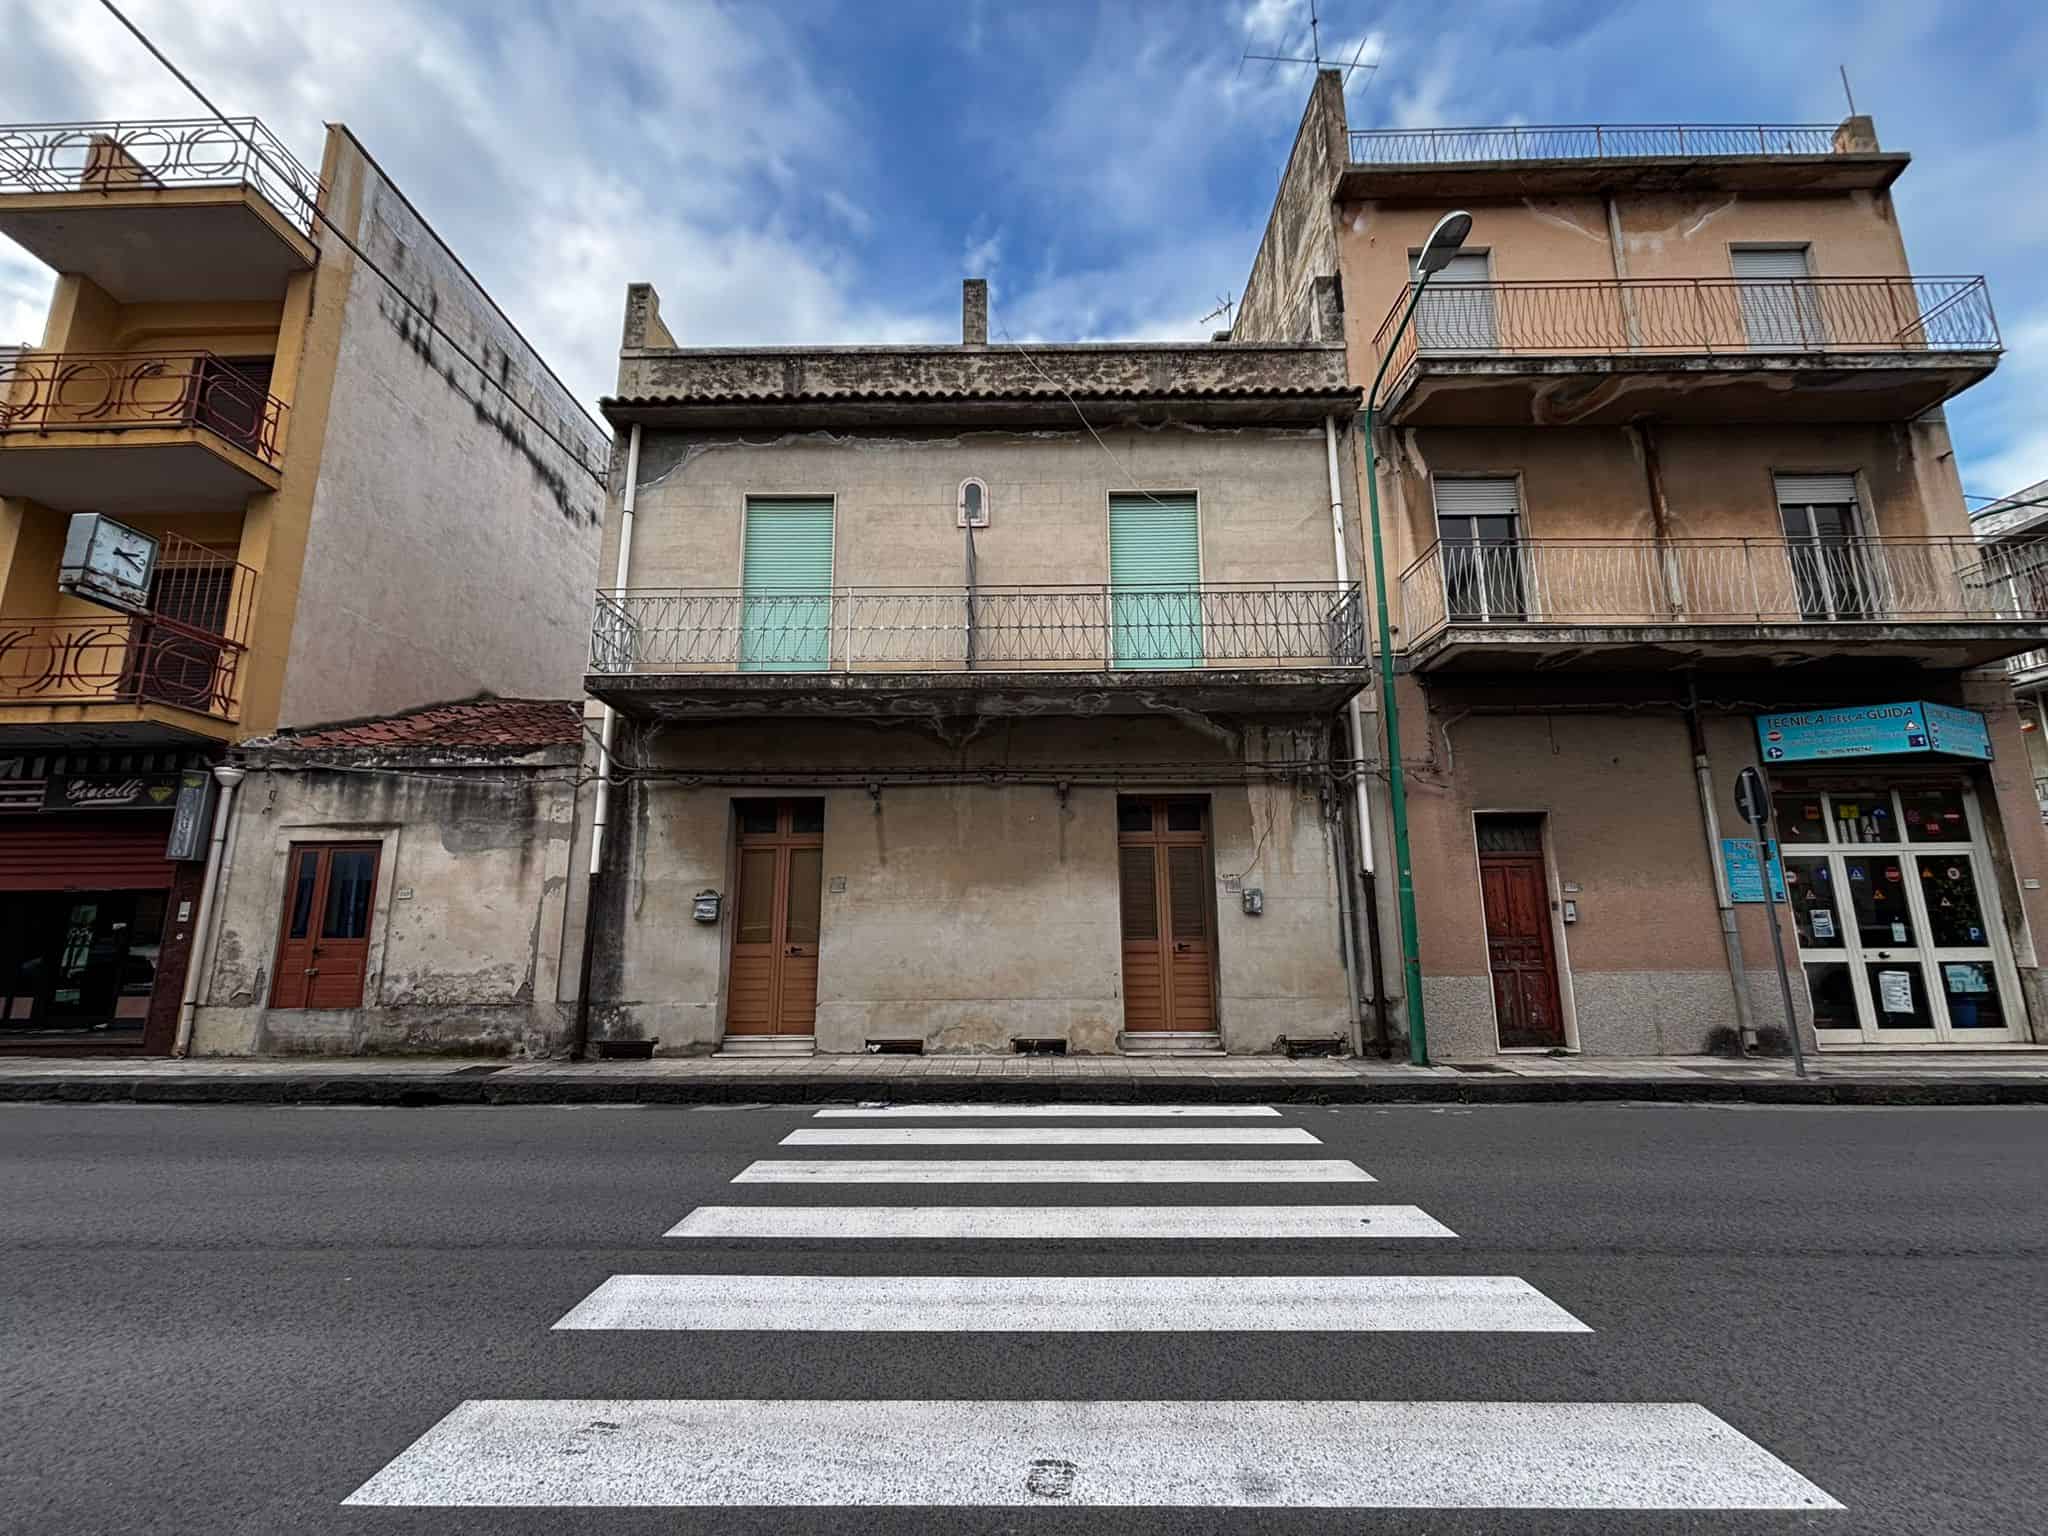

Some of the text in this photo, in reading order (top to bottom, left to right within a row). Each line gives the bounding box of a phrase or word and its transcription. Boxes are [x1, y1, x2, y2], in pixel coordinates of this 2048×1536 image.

[1767, 713, 1825, 729] TECNICA
[1866, 706, 1914, 720] GUIDA
[65, 778, 144, 801] Gioielli
